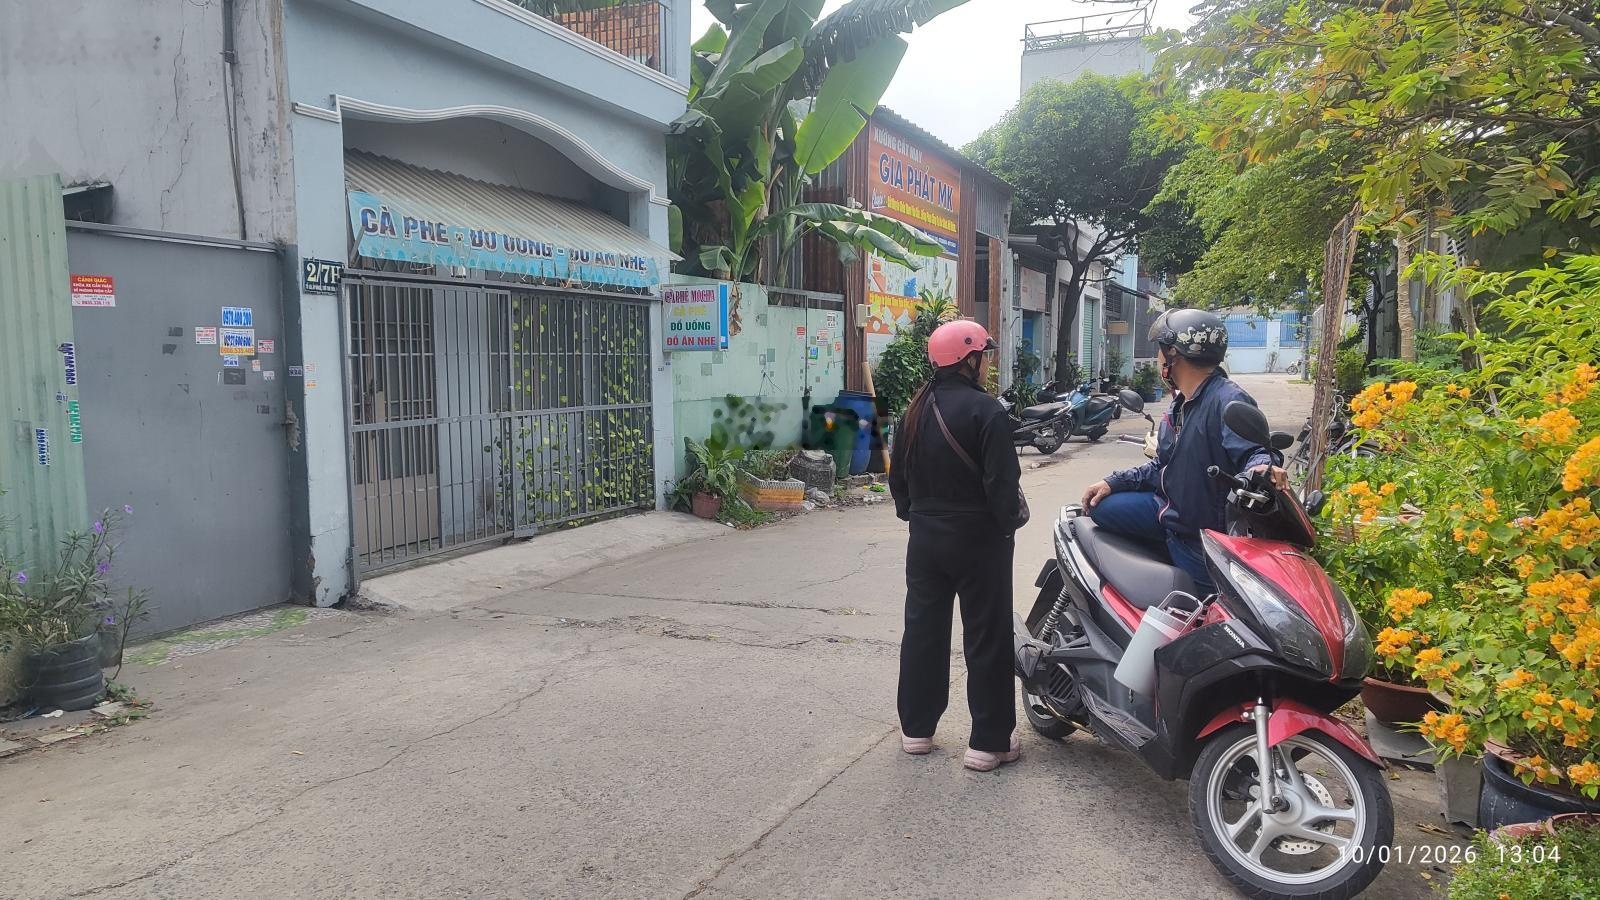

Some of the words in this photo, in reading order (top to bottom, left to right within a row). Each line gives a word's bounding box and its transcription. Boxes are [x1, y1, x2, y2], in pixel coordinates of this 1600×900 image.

[879, 152, 904, 191] GIA
[907, 167, 936, 203] PHÁT
[938, 180, 954, 212] MK
[360, 205, 397, 238] CÀ
[306, 262, 341, 284] 2/7H
[685, 318, 711, 331] UỐNG
[1223, 624, 1245, 648] HONDA
